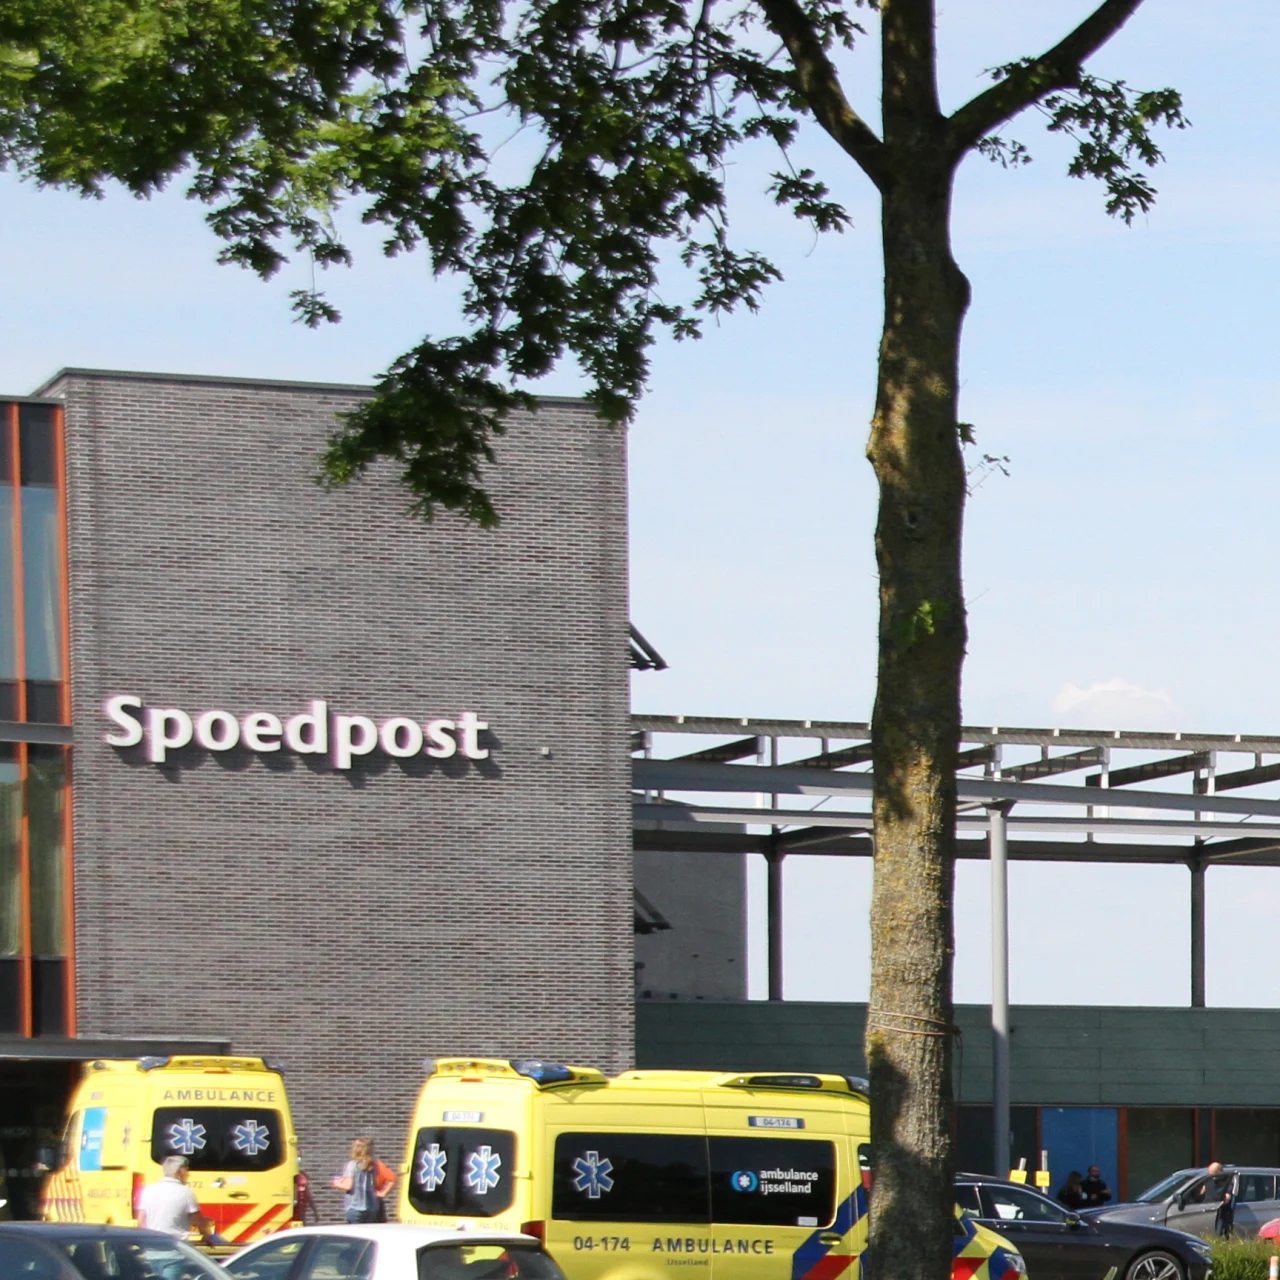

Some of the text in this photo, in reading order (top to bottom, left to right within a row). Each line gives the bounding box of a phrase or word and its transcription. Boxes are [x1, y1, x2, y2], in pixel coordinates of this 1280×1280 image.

[105, 695, 489, 769] Spoedpost
[164, 1089, 276, 1102] AMBULANCE
[763, 1118, 792, 1128] 04-174
[760, 1168, 819, 1181] ambulance
[760, 1181, 812, 1195] ijsselland
[574, 1236, 774, 1254] 04-174 AMBULANCE
